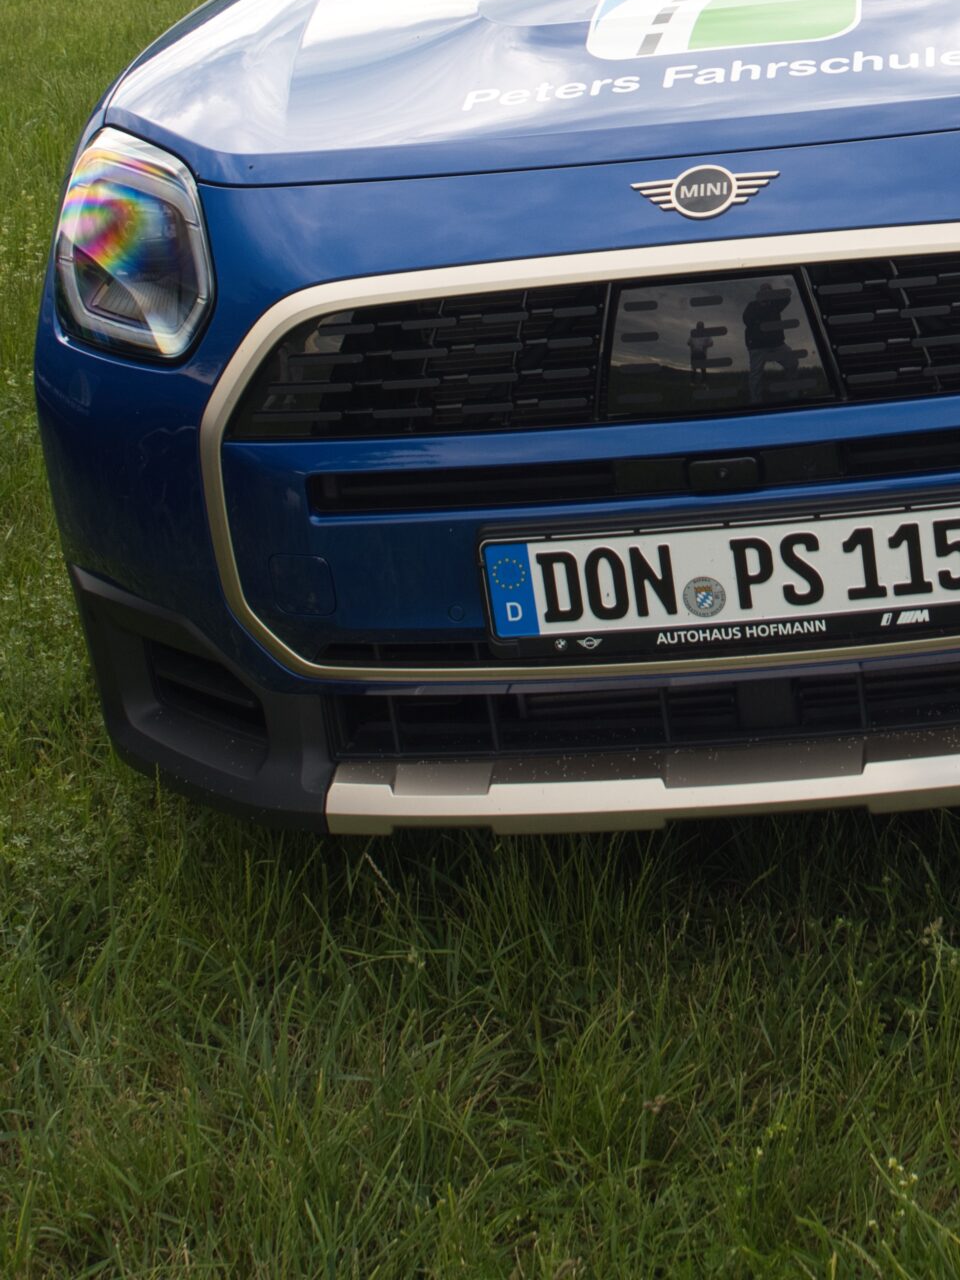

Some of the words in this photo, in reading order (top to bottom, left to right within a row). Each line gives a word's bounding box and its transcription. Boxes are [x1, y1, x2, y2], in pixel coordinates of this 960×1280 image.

[461, 74, 641, 112] Peters
[679, 180, 729, 200] MINI
[506, 601, 524, 622] D
[536, 543, 679, 624] DON
[729, 531, 825, 611] PS
[656, 626, 742, 647] AUTOHAUS
[745, 619, 828, 641] HOFMANN
